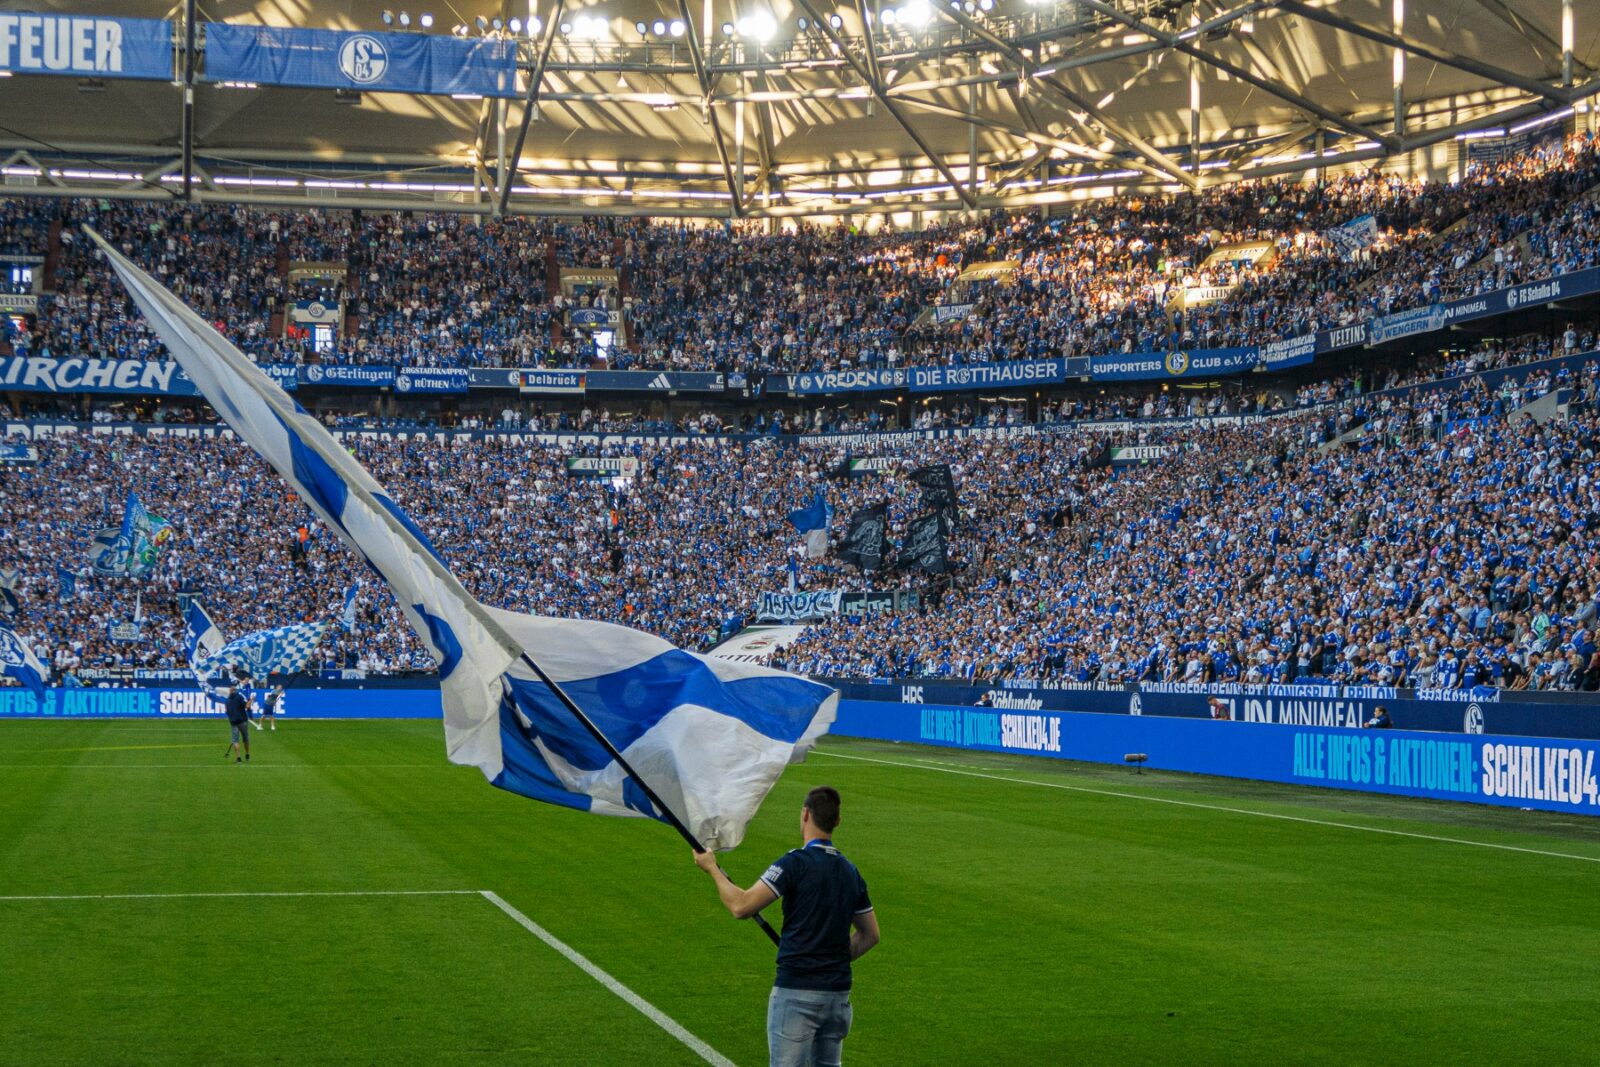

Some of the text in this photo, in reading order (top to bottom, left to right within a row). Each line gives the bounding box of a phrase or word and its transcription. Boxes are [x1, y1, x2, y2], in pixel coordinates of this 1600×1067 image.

[0, 16, 123, 72] FEUER
[1201, 289, 1234, 299] VELTIN
[1519, 281, 1561, 303] FC Schalke 04
[1455, 301, 1487, 317] MINIMEAL
[1330, 324, 1366, 348] VELTINS
[1384, 320, 1429, 338] WENGERN
[1093, 355, 1243, 374] SUPPORTERS CLUB e.V.
[0, 357, 177, 392] IRCHEN
[414, 377, 449, 389] RÜTHEN
[528, 373, 577, 385] Delbrück
[815, 370, 878, 389] VREDEN
[916, 370, 942, 386] DIE
[1134, 447, 1163, 459] VELTI
[591, 460, 621, 470] VELTI
[42, 690, 56, 715] &
[63, 690, 155, 715] AKTIONEN:
[921, 709, 935, 739] ALLE
[936, 710, 955, 742] INFOS
[1001, 713, 1061, 752] SCHALKE04.DE
[1293, 733, 1325, 778] ALLE
[1328, 735, 1371, 784] INFOS
[1374, 737, 1386, 785] &
[1389, 739, 1478, 794] AKTIONEN:
